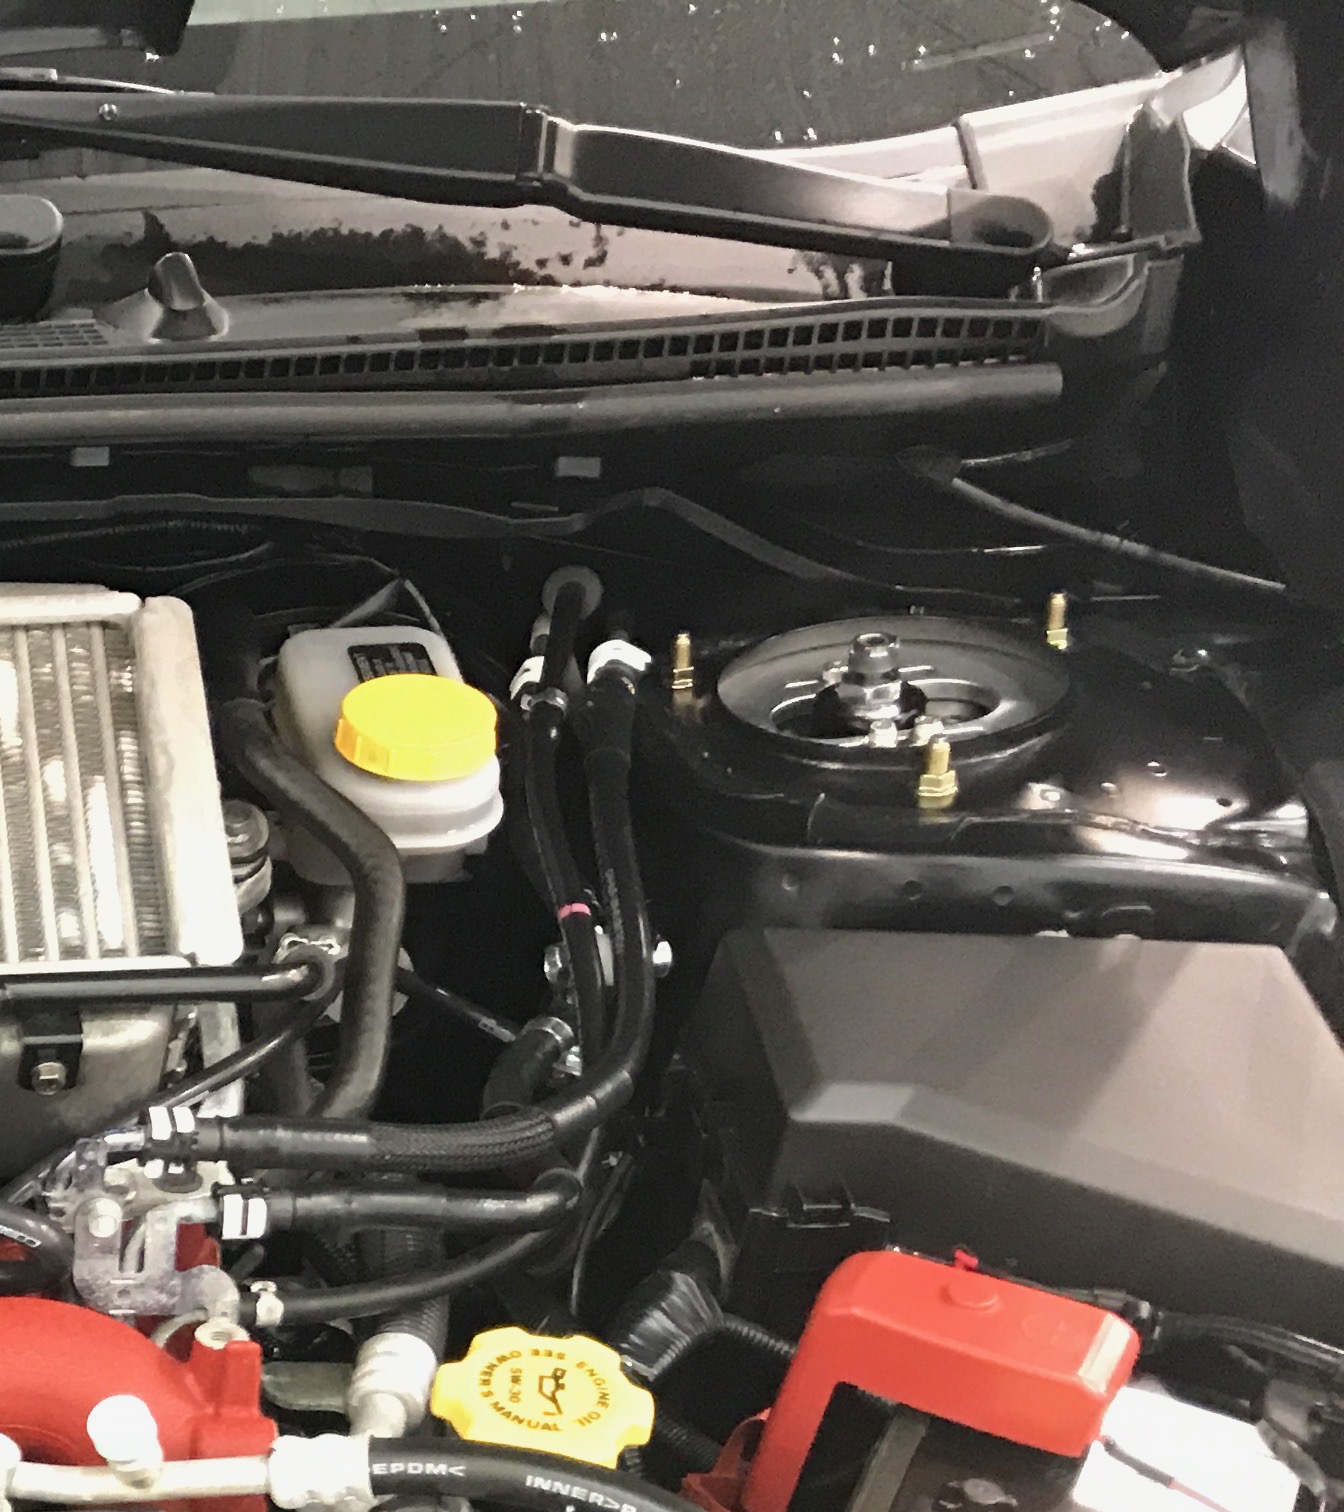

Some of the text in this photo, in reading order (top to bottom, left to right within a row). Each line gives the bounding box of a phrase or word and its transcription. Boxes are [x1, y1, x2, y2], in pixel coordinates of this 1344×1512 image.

[489, 1401, 563, 1431] MANUAL
[575, 1361, 610, 1427] ENGINE OIL
